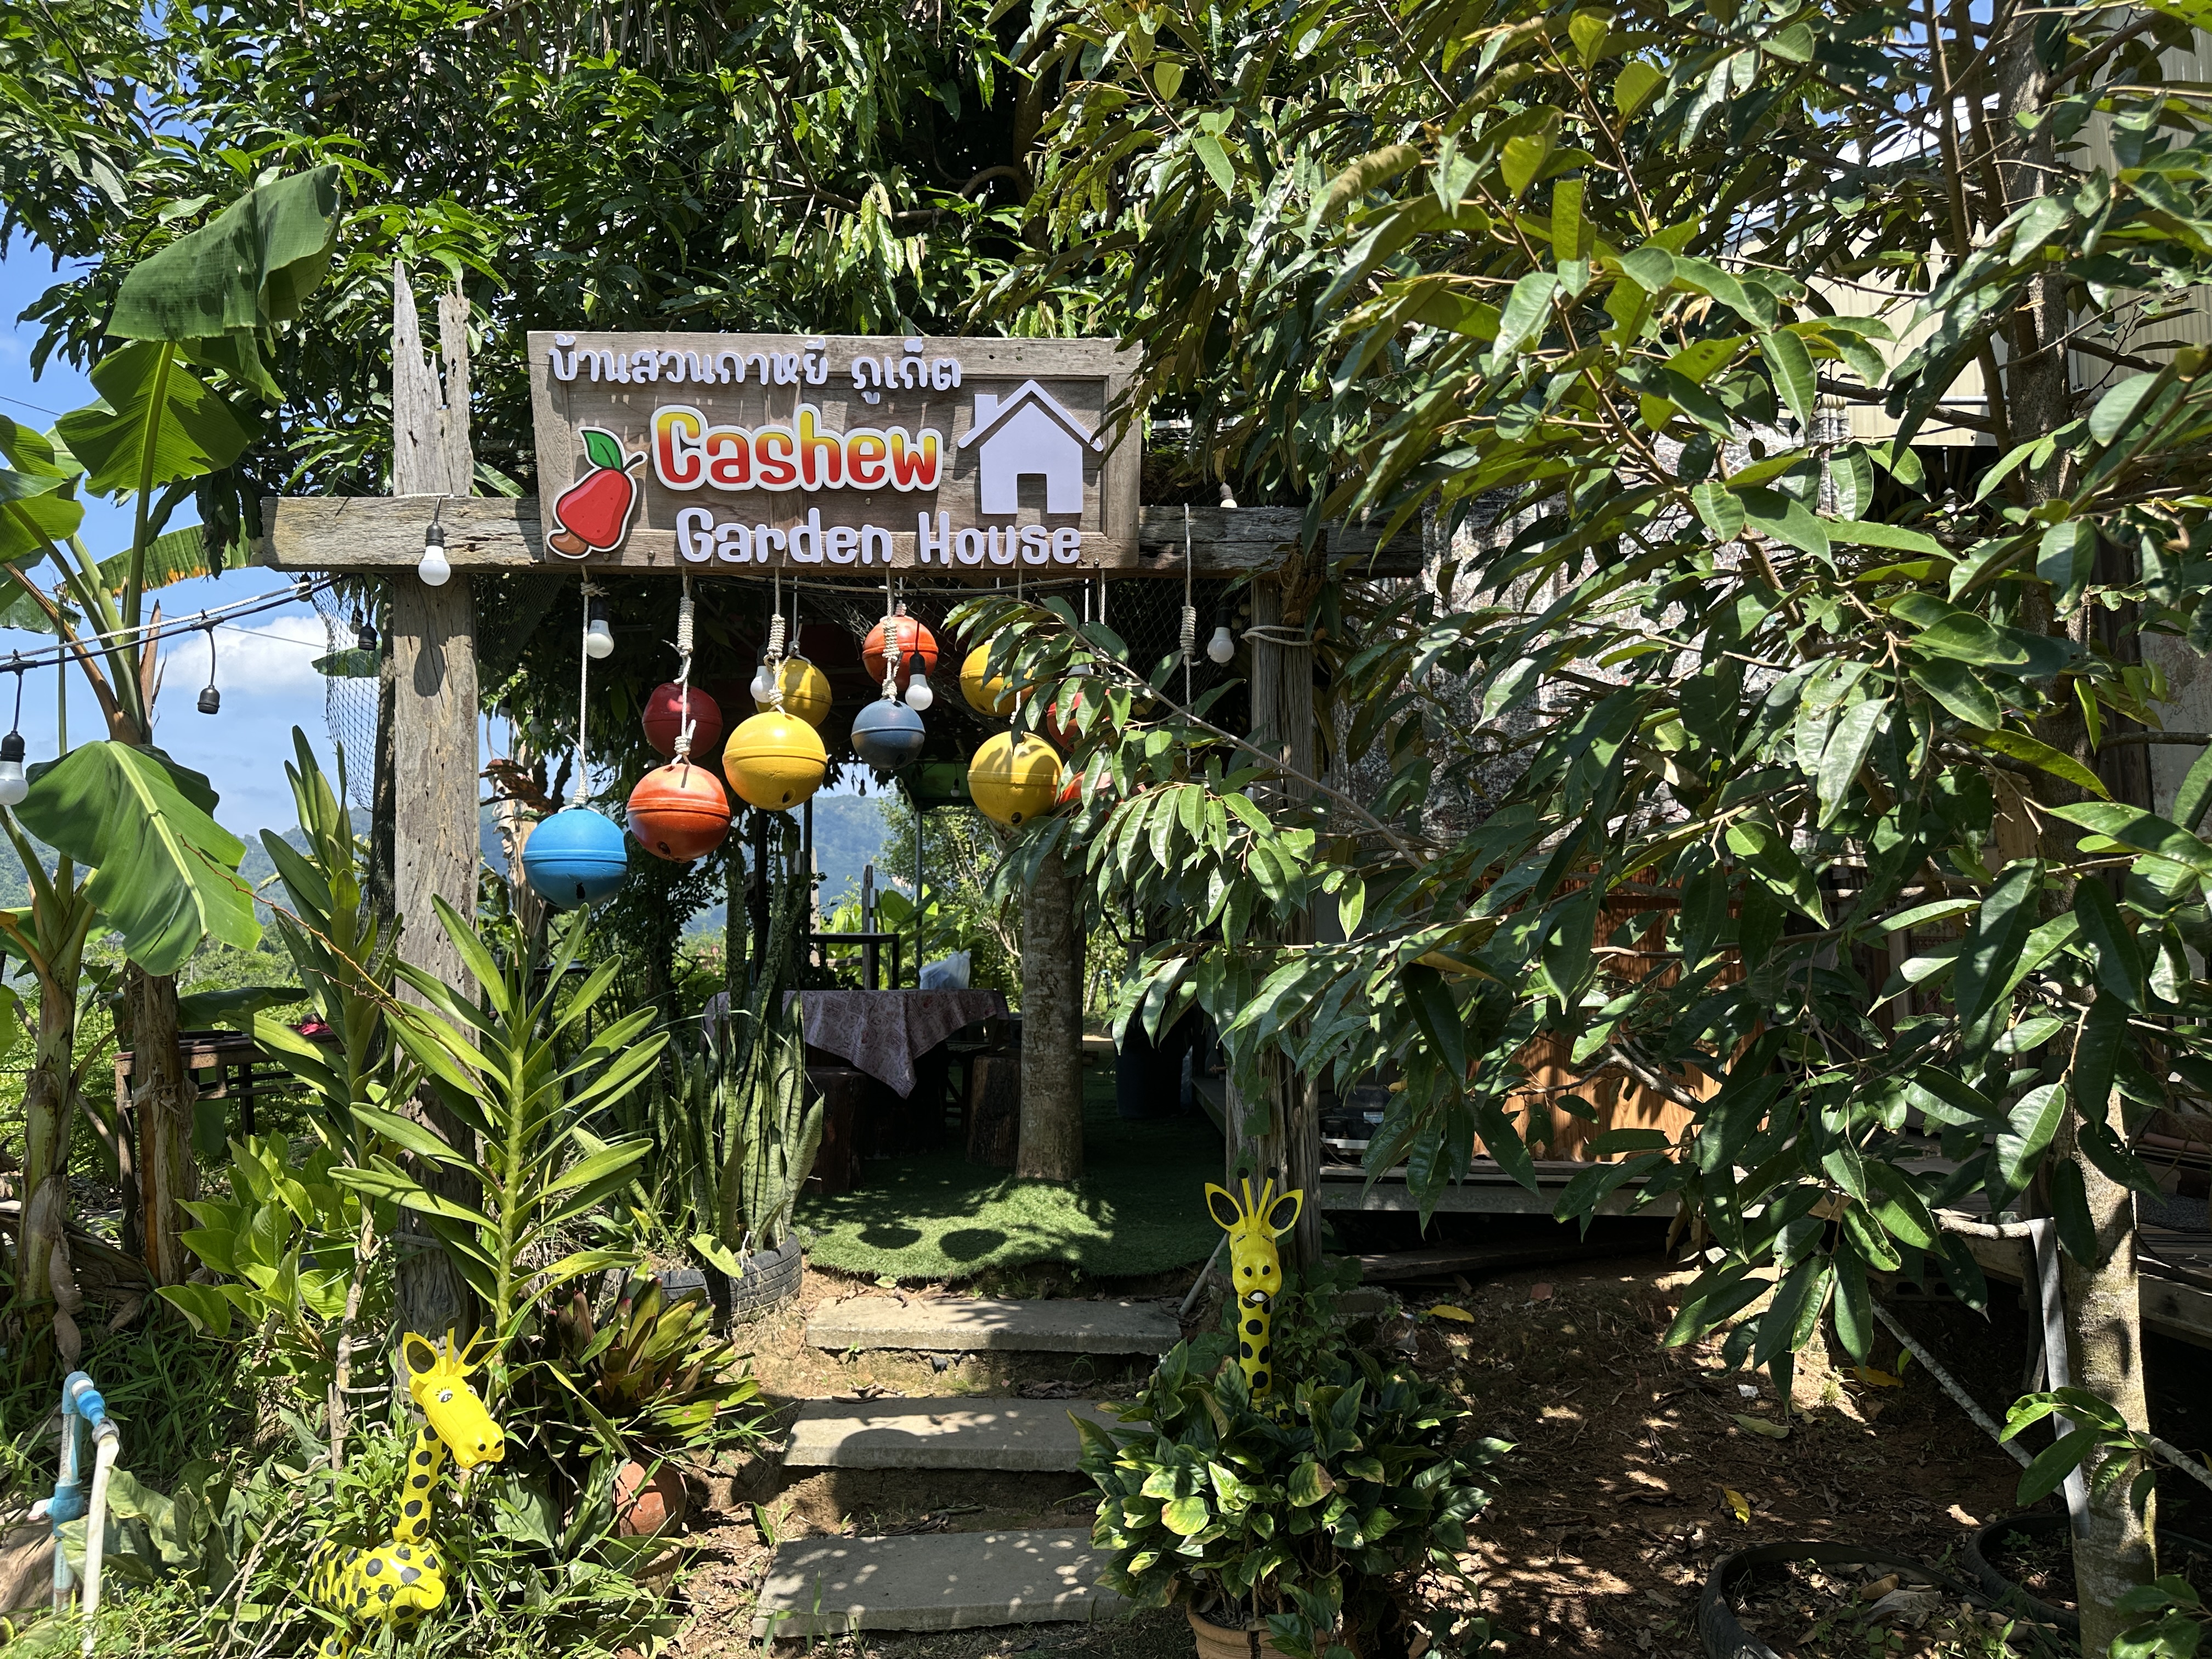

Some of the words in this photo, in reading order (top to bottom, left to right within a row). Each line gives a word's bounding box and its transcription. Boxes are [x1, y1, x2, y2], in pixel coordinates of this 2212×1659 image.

[851, 337, 962, 405] ภูเก็ต
[654, 407, 939, 488] Cashew
[676, 507, 893, 565] Garden
[918, 511, 1081, 565] House
